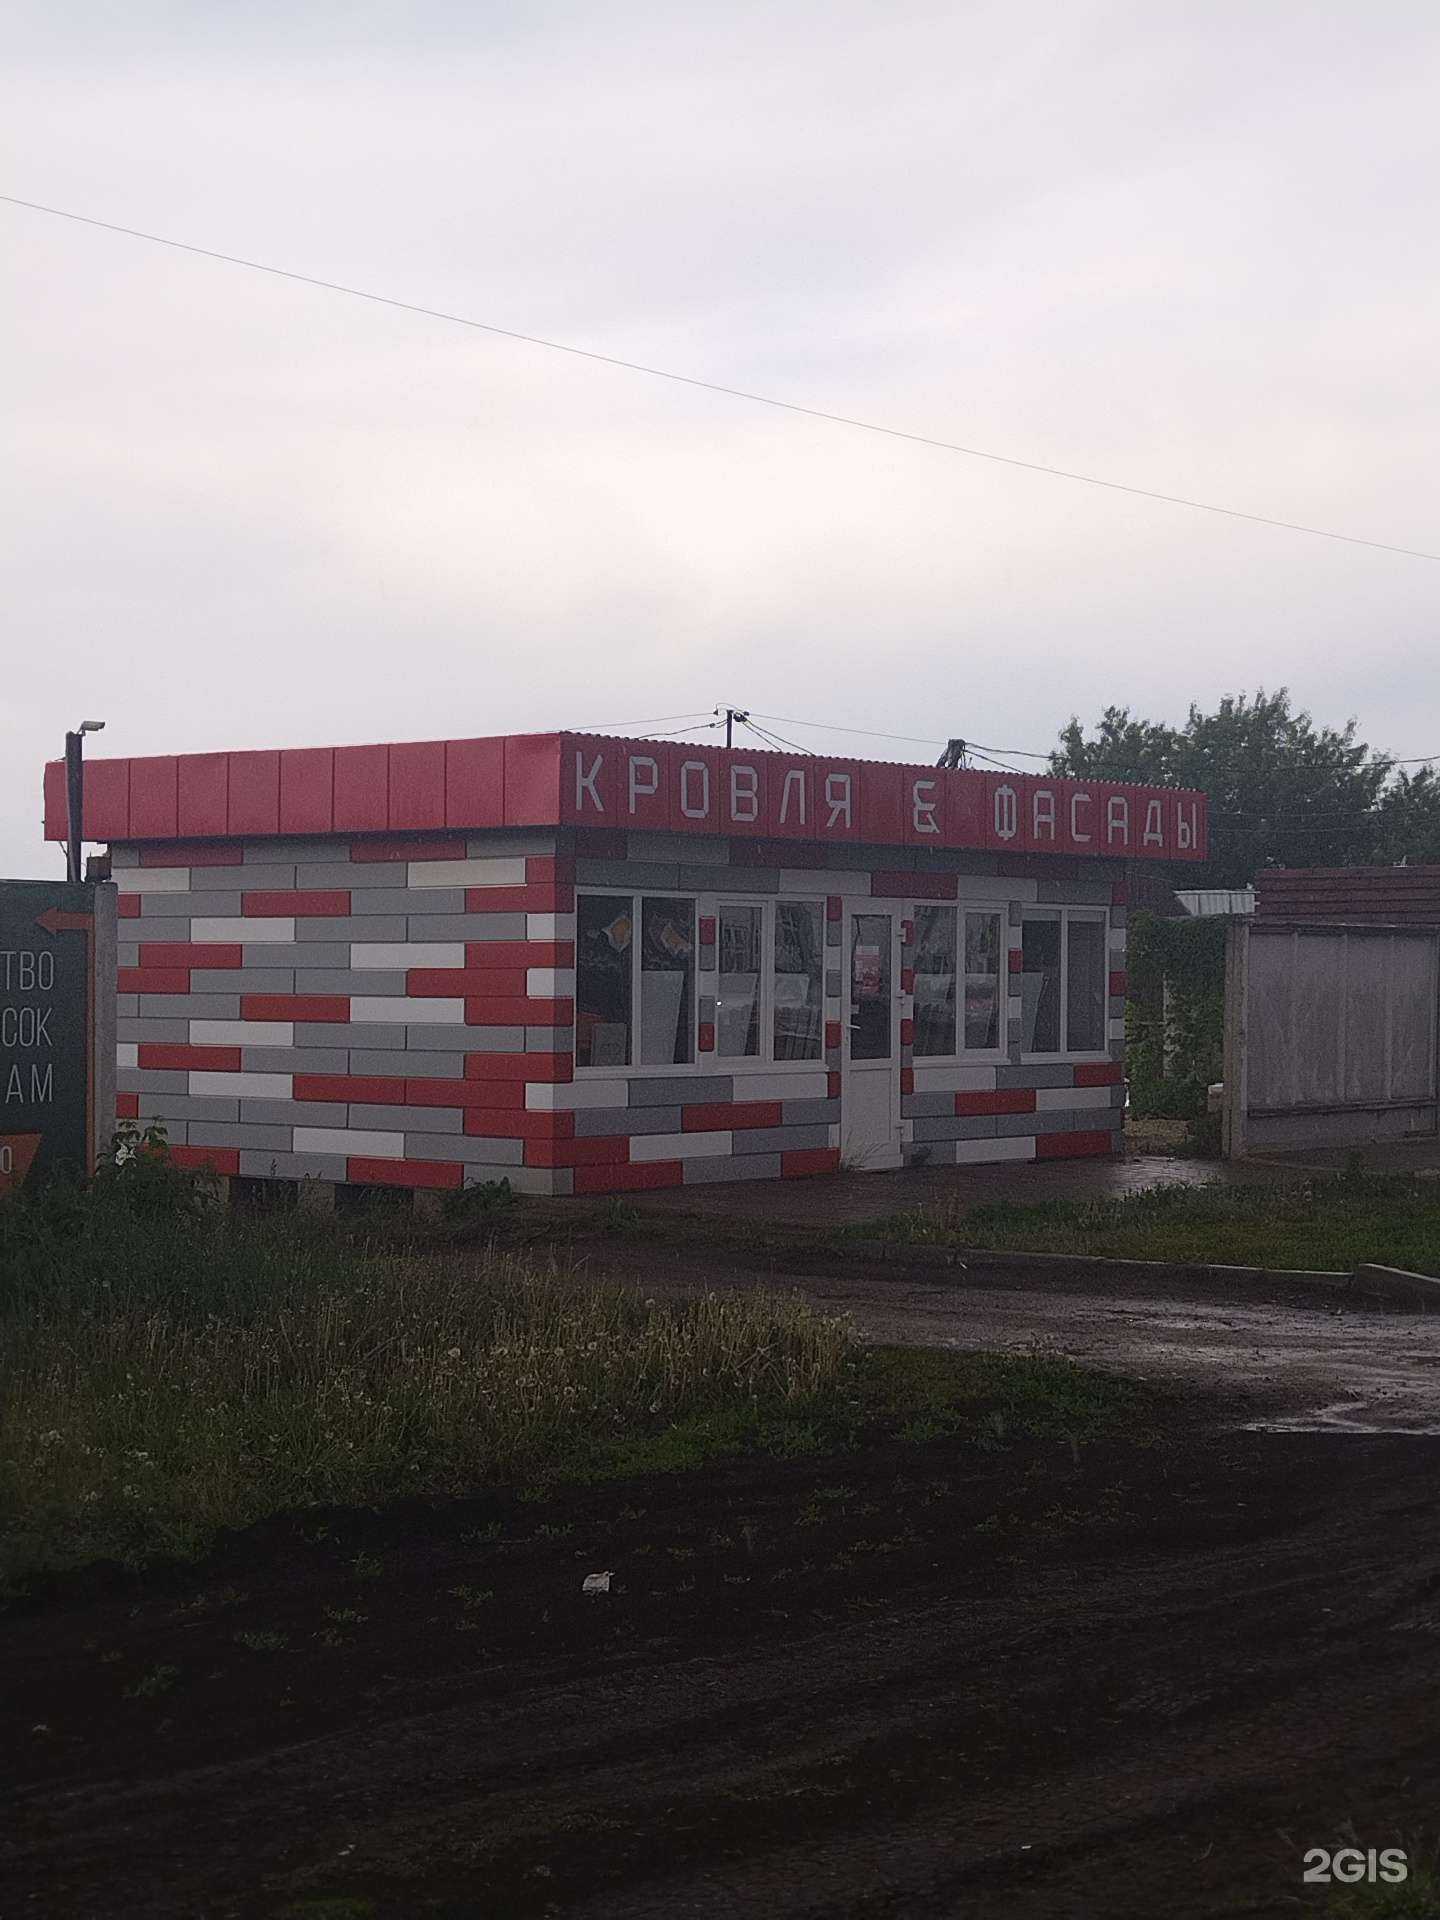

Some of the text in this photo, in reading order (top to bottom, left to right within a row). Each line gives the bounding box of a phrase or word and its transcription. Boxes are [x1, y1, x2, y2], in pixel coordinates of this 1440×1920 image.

[575, 751, 851, 829] КРОВЛЯ
[994, 783, 1197, 849] ФАСАДЫ
[0, 950, 54, 990] ТВО
[2, 1007, 53, 1047] СОК
